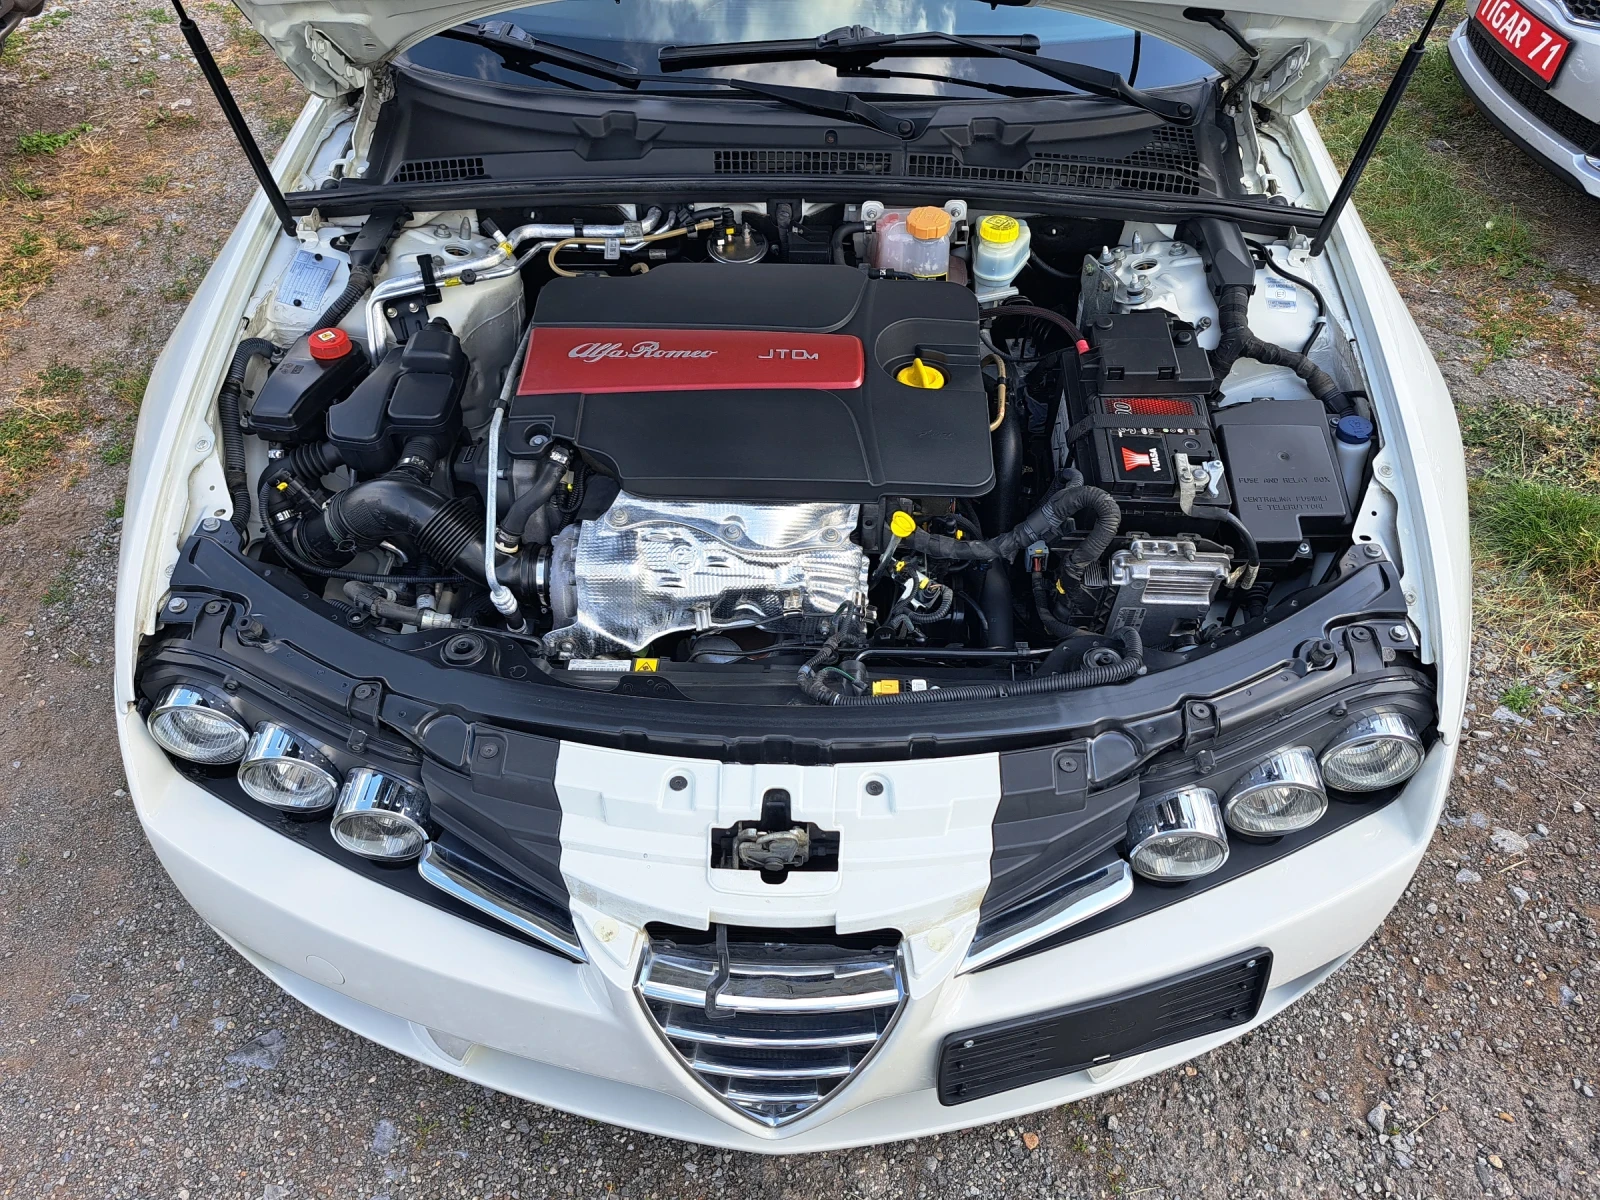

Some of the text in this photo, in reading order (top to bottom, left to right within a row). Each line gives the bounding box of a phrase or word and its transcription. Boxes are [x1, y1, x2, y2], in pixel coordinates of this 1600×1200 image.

[1527, 32, 1562, 70] 71
[568, 342, 630, 363] Alfa
[627, 341, 717, 359] Romeo
[1149, 447, 1162, 473] YUASA
[1282, 476, 1308, 484] RELAY
